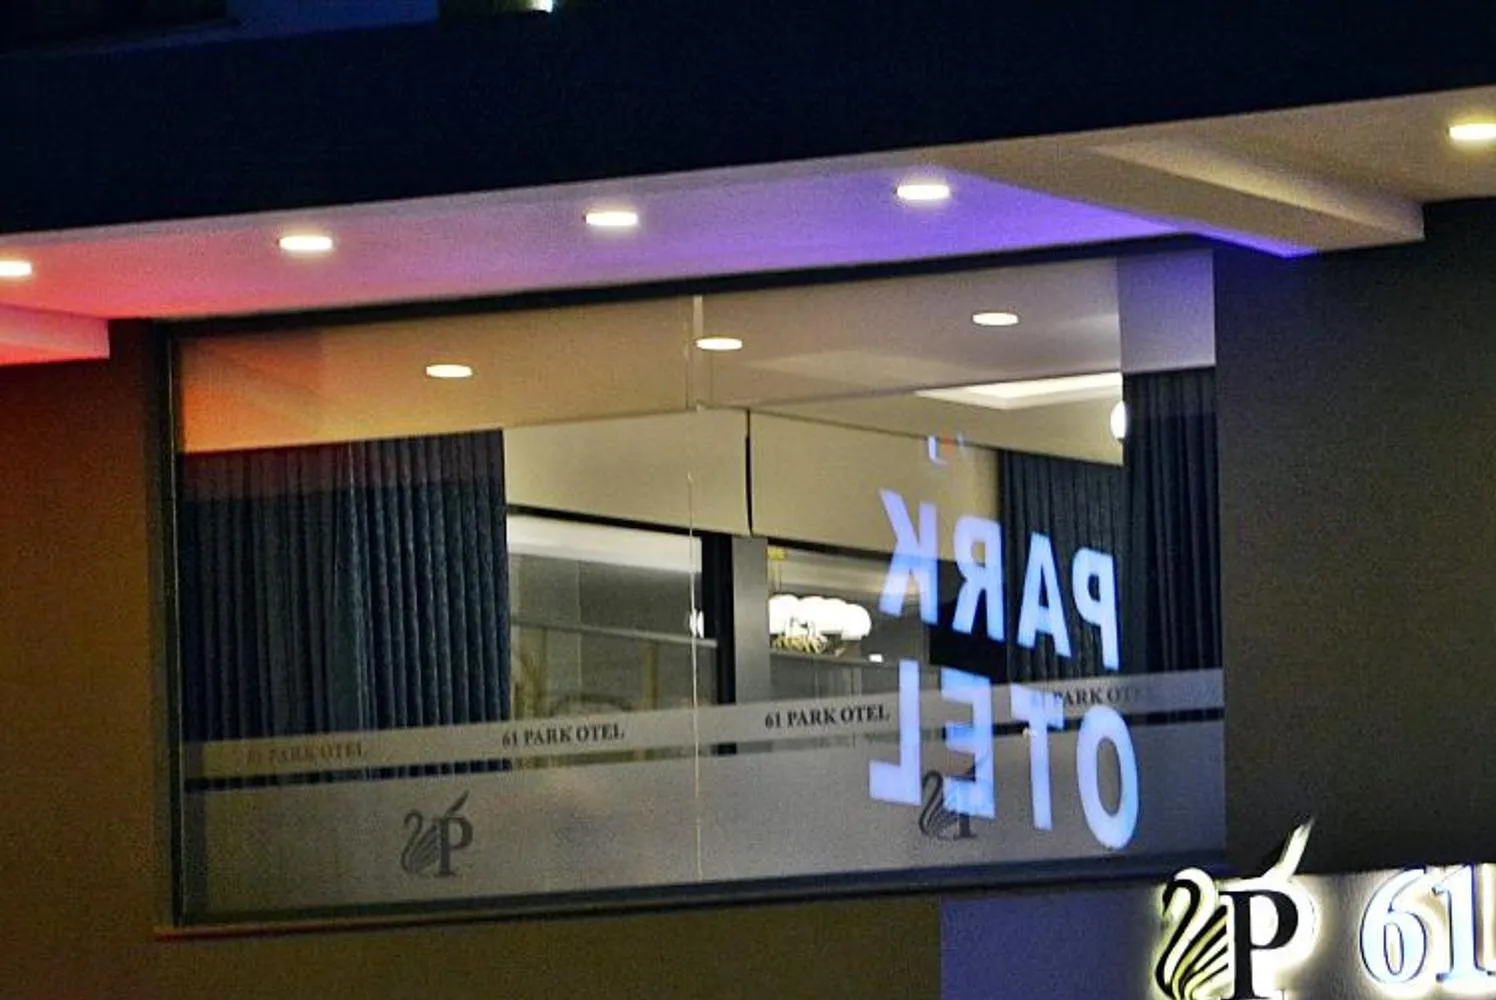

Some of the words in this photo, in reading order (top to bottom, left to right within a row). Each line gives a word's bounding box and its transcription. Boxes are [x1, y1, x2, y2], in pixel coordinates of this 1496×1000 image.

[765, 713, 780, 730] 61
[787, 707, 836, 728] PARK
[840, 703, 890, 722] OTEL
[502, 731, 517, 748] 61
[524, 726, 573, 745] PARK
[575, 722, 625, 742] OTEL
